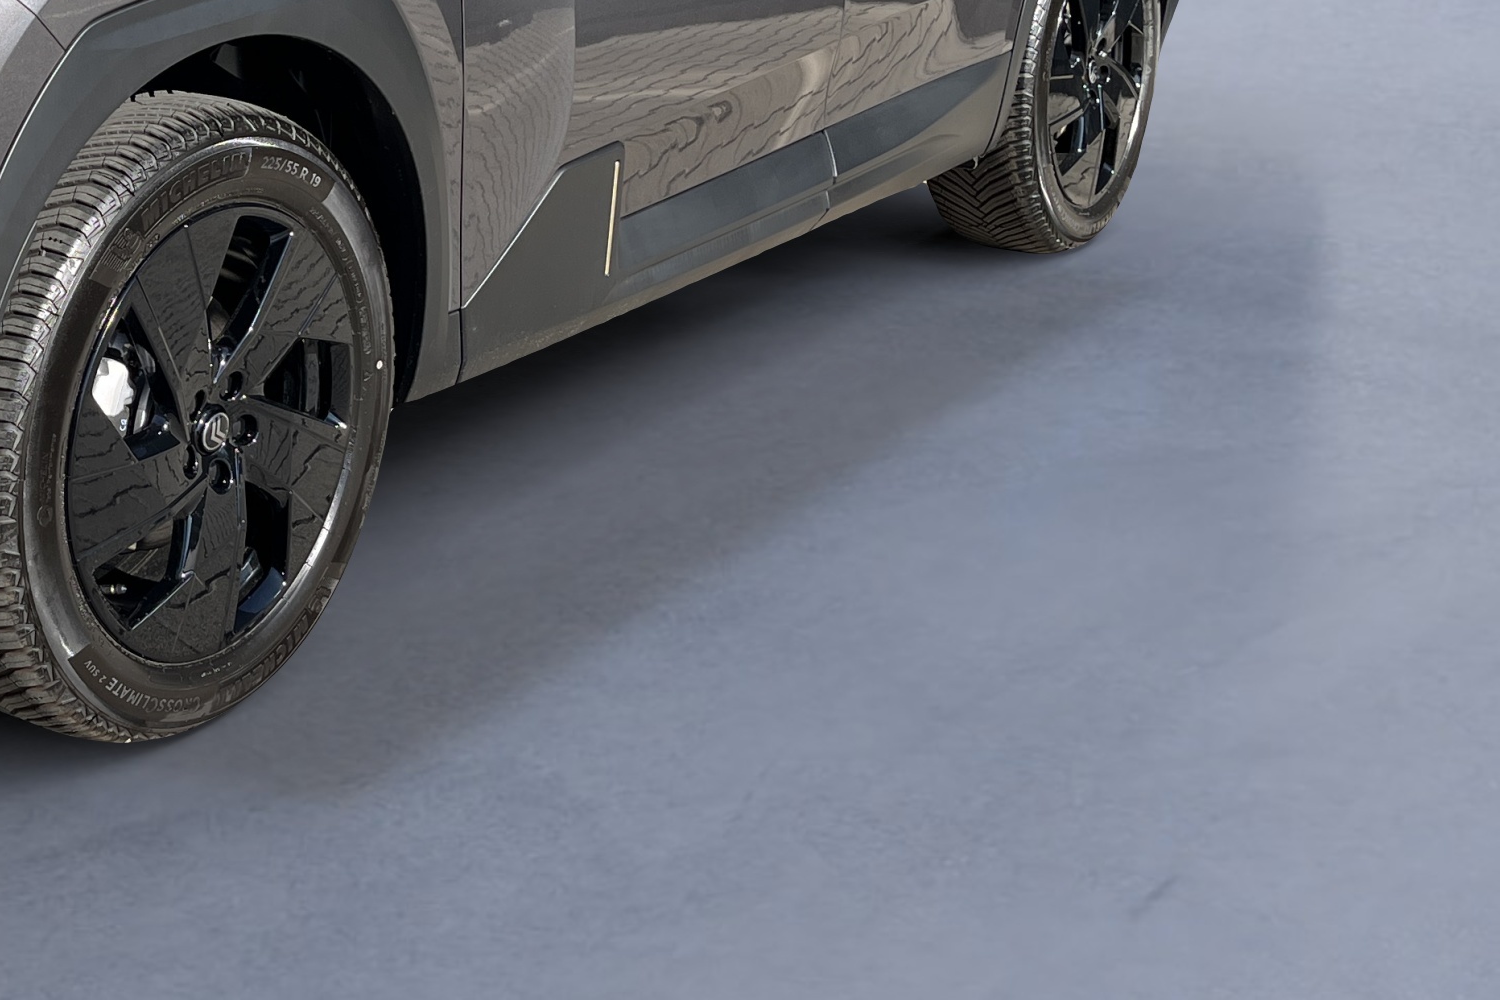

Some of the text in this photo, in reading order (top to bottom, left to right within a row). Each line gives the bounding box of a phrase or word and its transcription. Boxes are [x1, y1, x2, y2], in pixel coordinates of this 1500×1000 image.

[260, 155, 322, 188] 225/55 R 19
[140, 152, 247, 232] MICHELIN
[83, 660, 101, 677] SUV
